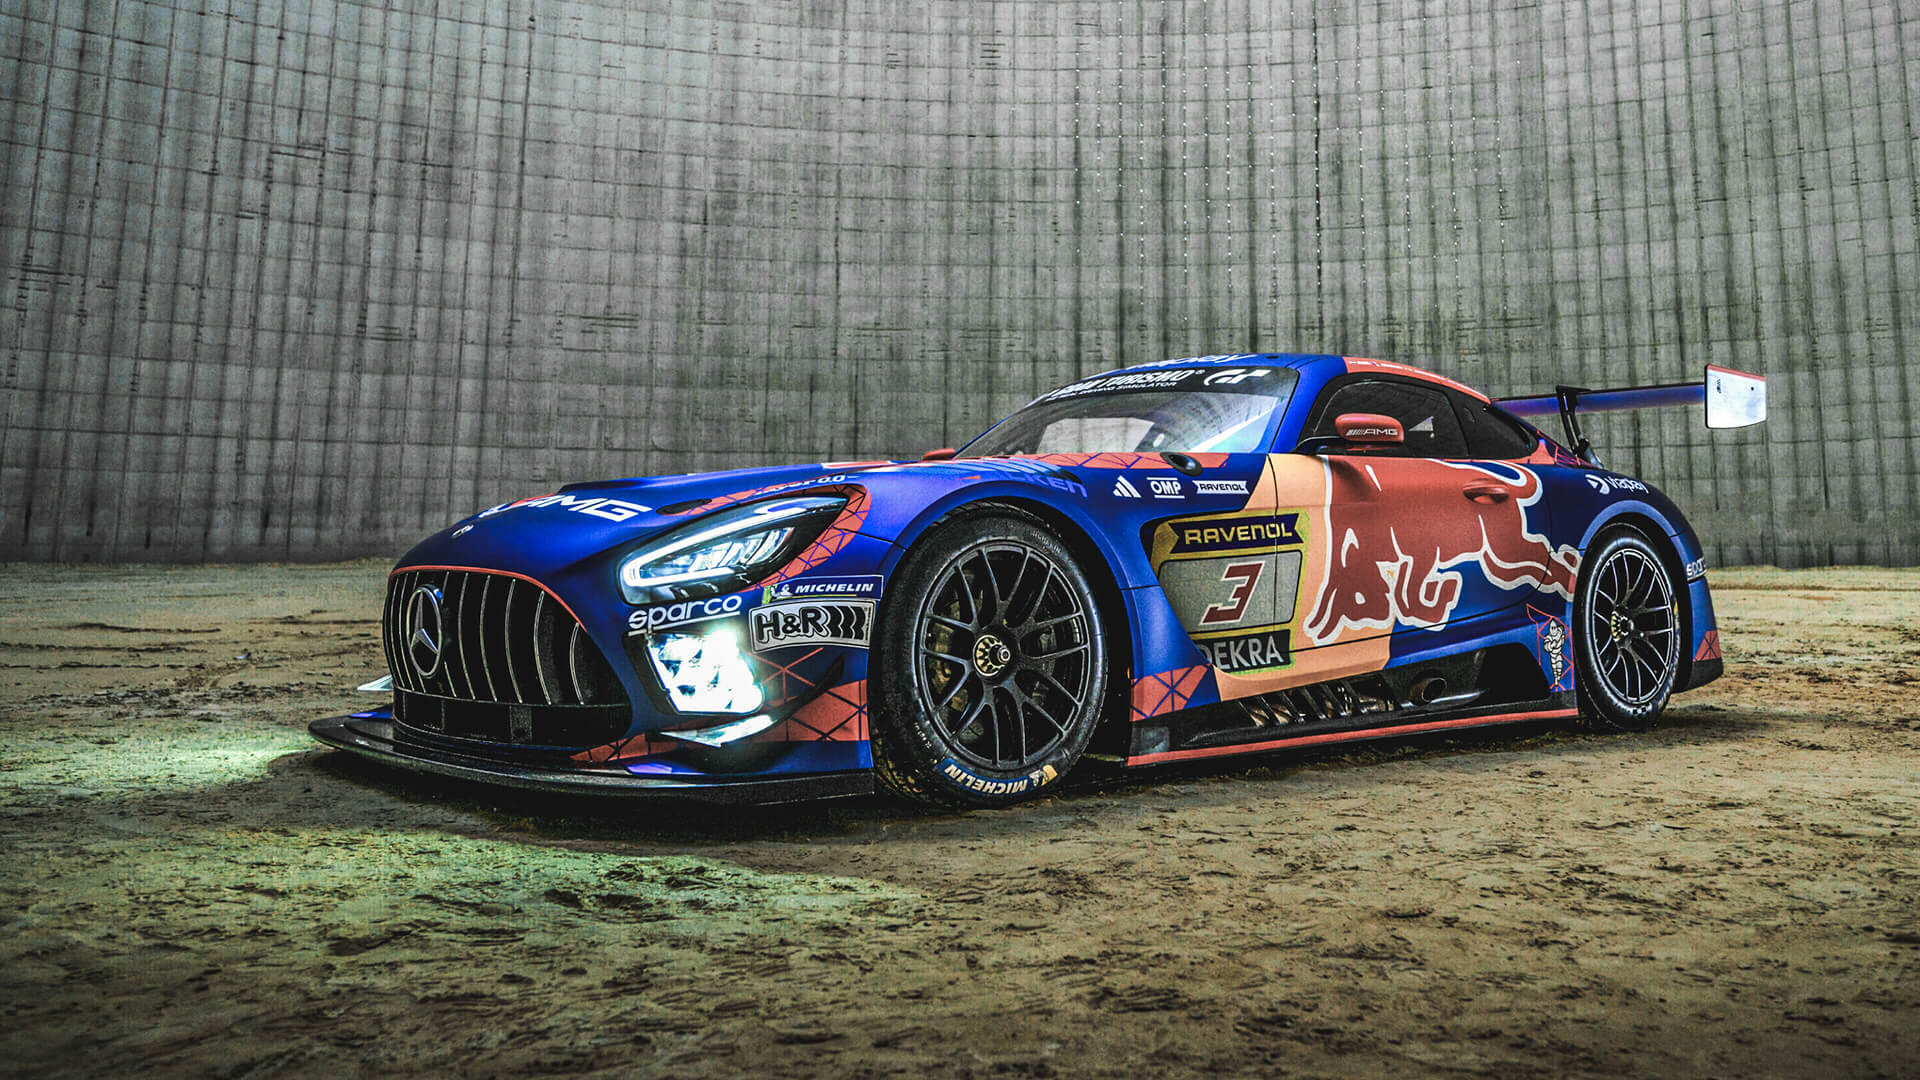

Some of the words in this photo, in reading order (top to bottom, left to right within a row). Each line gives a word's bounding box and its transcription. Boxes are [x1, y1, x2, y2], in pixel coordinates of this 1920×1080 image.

[1362, 428, 1398, 436] AMG
[1150, 479, 1182, 495] OMP
[1199, 482, 1246, 492] RAVENOL
[1184, 522, 1293, 545] RAVENOL
[794, 582, 874, 594] MICHELIN
[1200, 560, 1266, 625] 3
[628, 595, 742, 632] sparco
[755, 605, 824, 644] H&R
[943, 763, 1029, 795] MICHELIN
